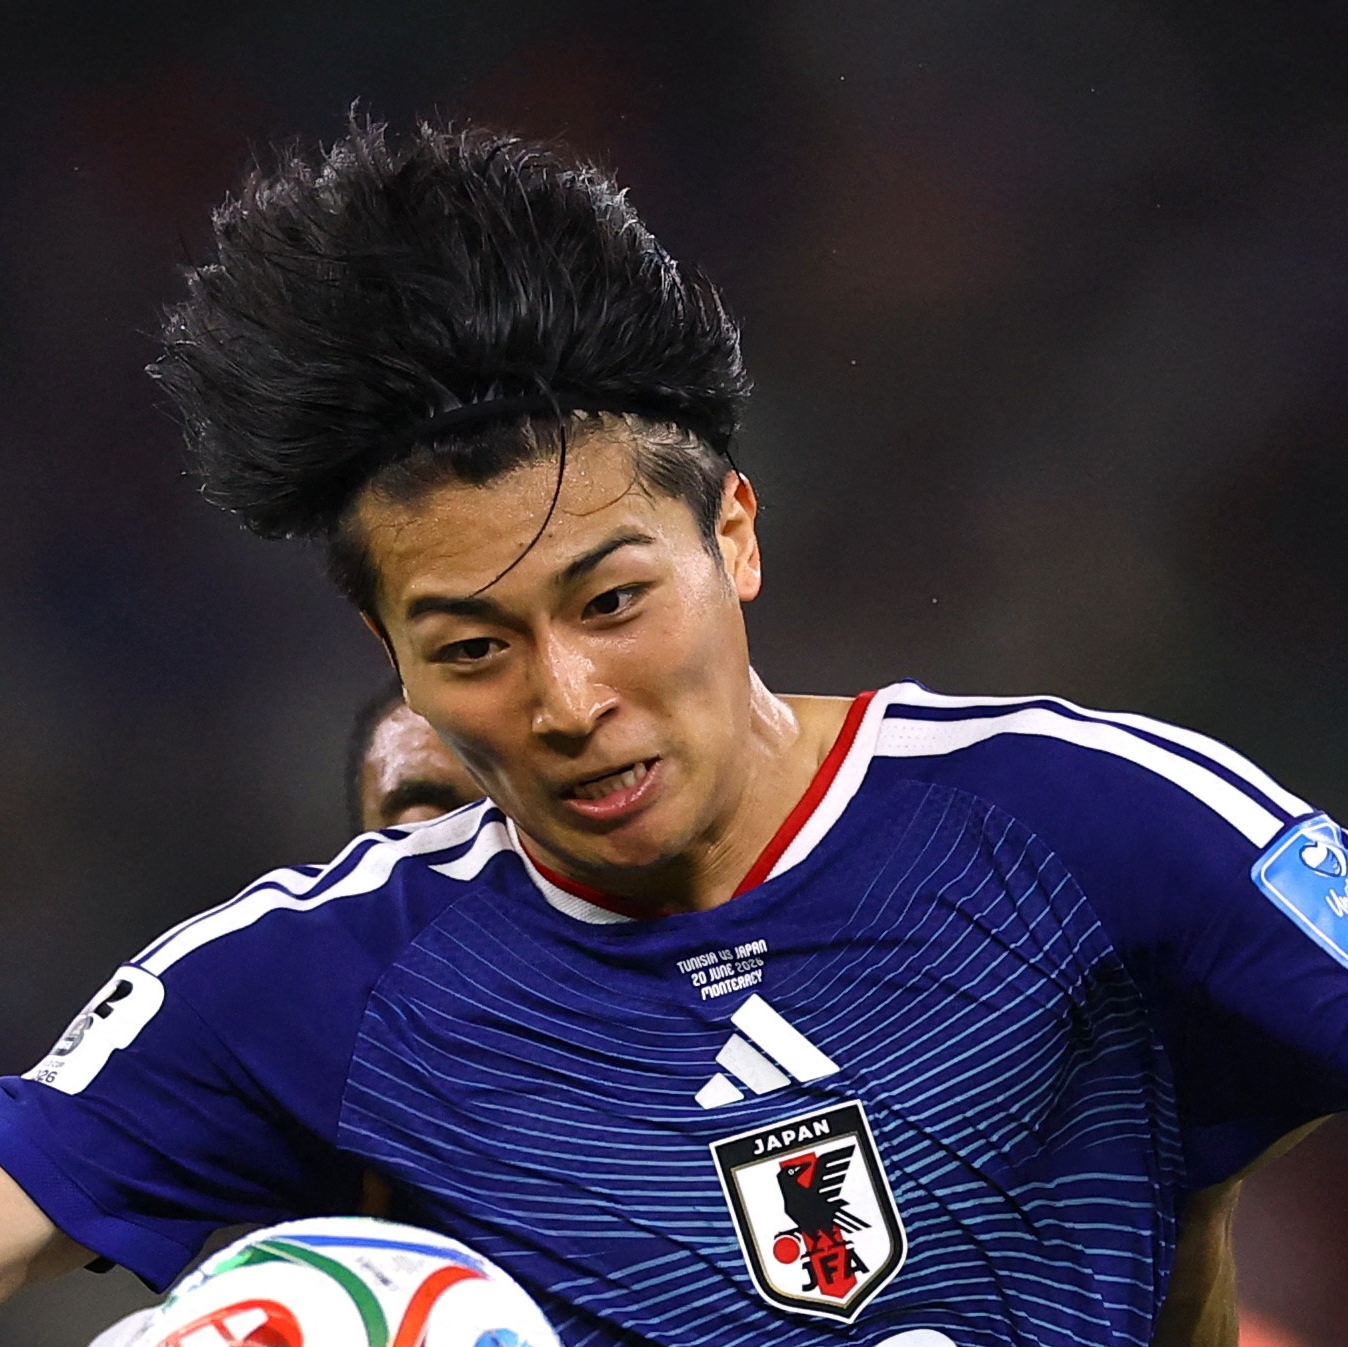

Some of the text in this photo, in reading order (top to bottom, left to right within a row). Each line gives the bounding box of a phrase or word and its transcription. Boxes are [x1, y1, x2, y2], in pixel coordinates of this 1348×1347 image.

[676, 951, 719, 974] TUNISIA
[734, 939, 768, 958] JAPAN
[691, 956, 765, 987] 20 JUNE 2026
[701, 968, 763, 1001] MONTERREY
[753, 1119, 831, 1155] JAPAN
[801, 1247, 870, 1292] JFA
